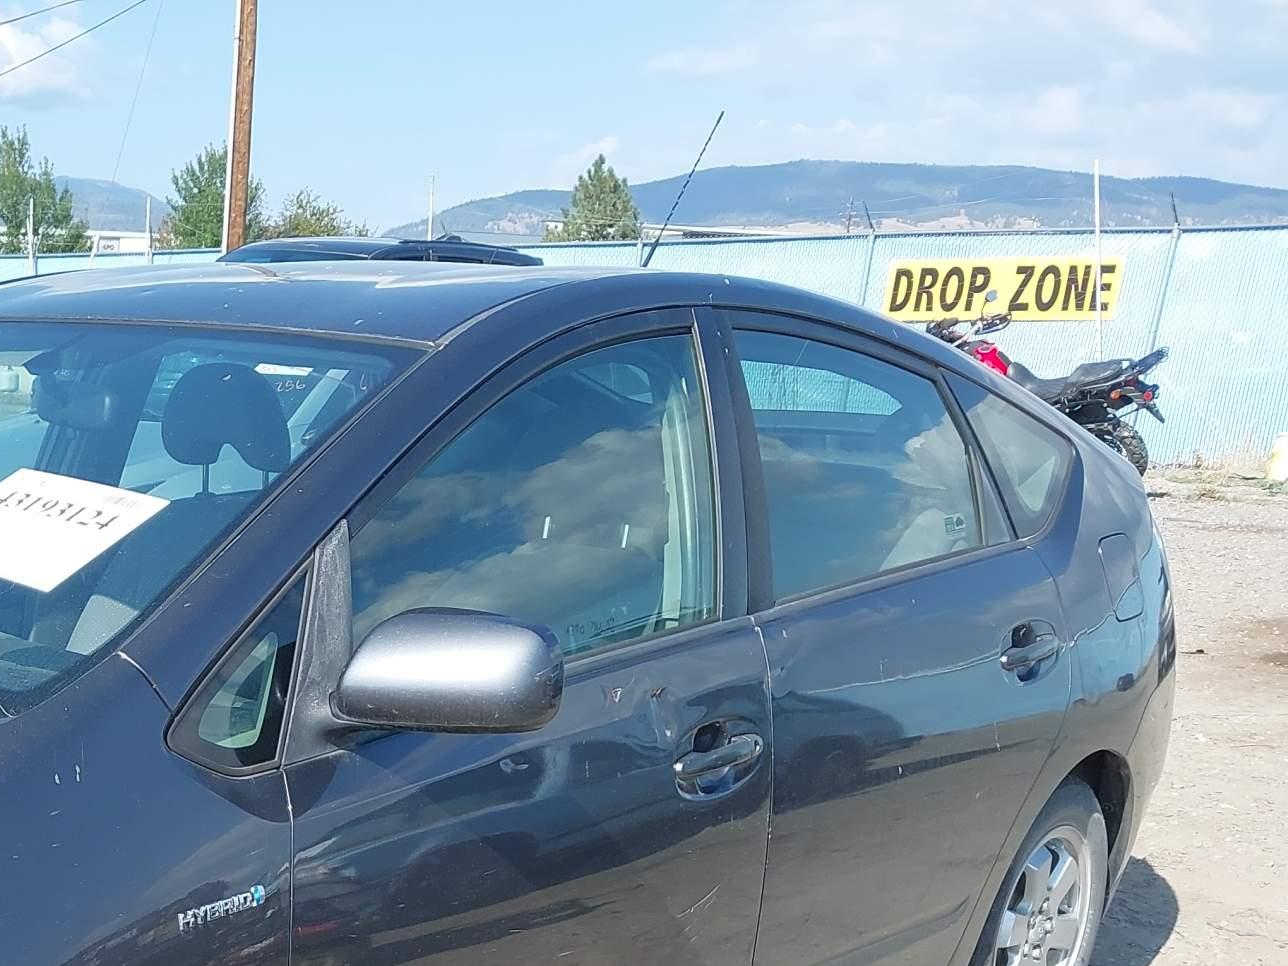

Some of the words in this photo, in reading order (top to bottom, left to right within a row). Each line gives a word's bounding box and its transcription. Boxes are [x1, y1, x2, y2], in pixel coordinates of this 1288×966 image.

[889, 266, 991, 312] DROP
[1008, 264, 1116, 312] ZONE
[177, 891, 256, 932] HYBRID
